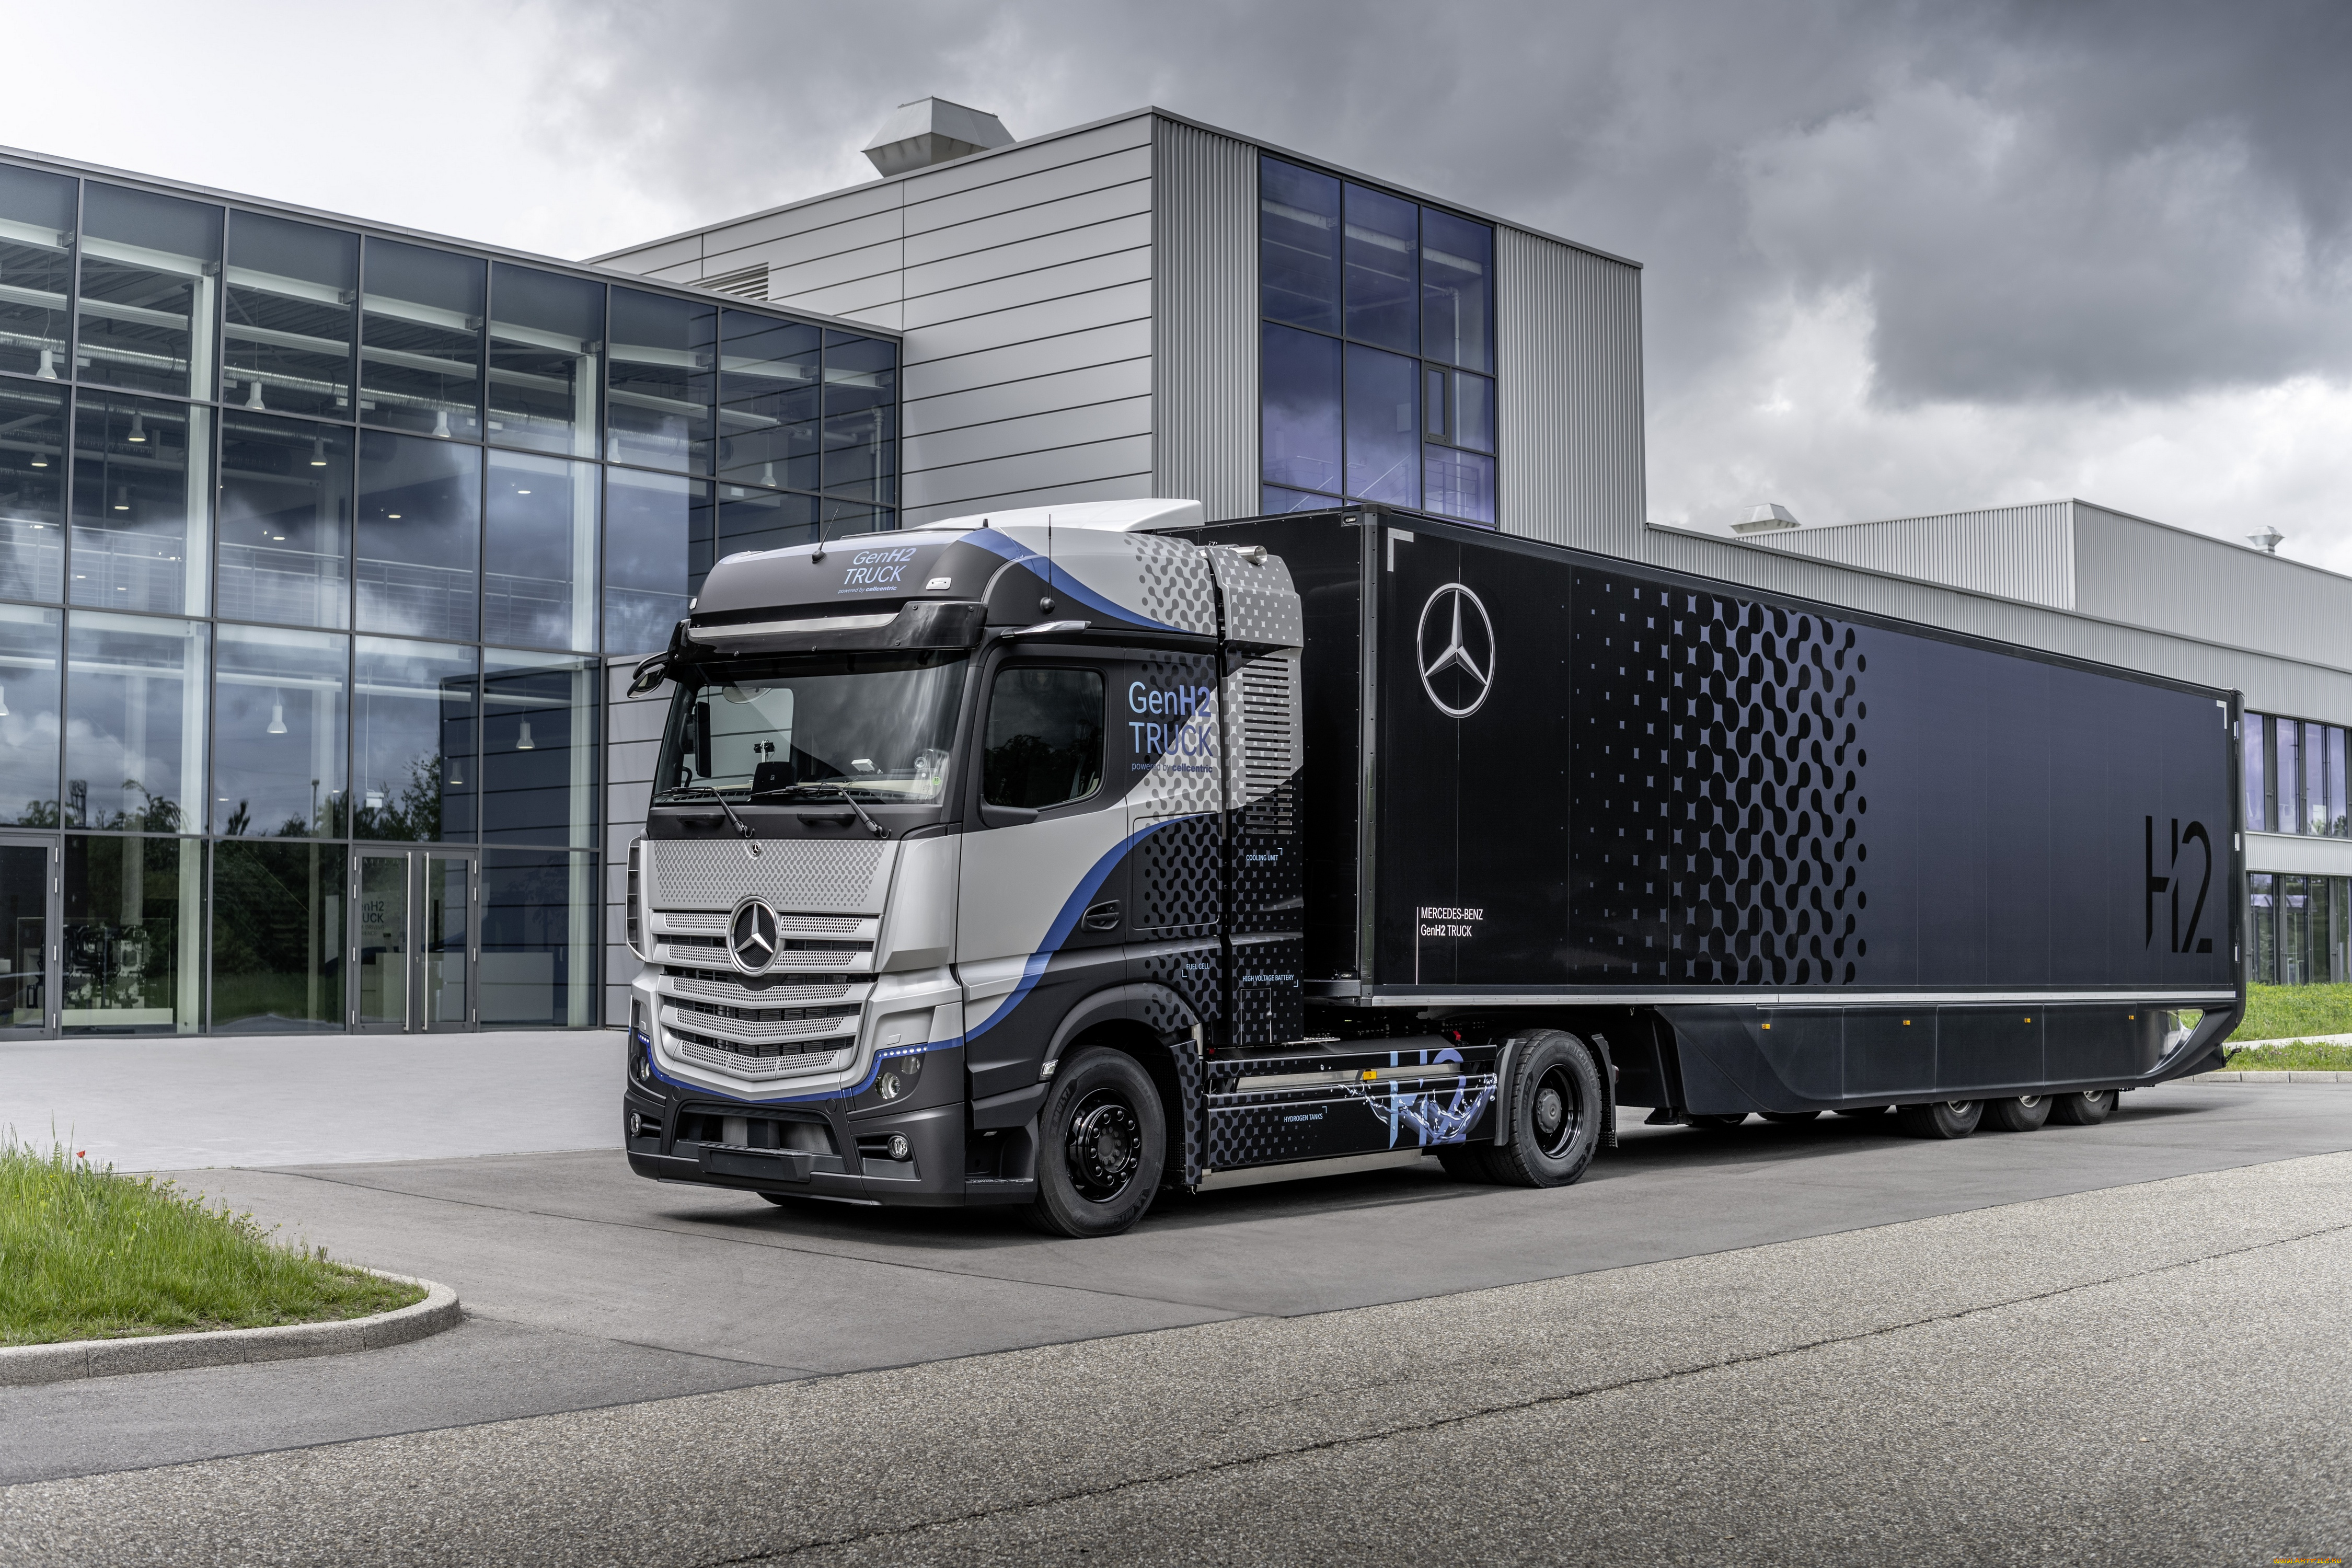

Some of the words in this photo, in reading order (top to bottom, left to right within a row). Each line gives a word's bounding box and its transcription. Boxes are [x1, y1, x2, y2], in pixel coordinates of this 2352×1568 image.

[853, 548, 917, 565] GenH2
[844, 565, 907, 585] TRUCK
[1128, 681, 1212, 718] GenH2
[1128, 721, 1214, 757] TRUCK
[1132, 762, 1161, 771] powered
[1162, 763, 1171, 773] by
[1172, 763, 1213, 773] cellcentric
[2146, 815, 2212, 954] H2
[1421, 907, 1483, 920] MERCEDES-BENZ
[1421, 924, 1446, 936] GenH2
[1447, 925, 1472, 937] TRUCK
[1566, 1042, 1597, 1090] MICHELIN
[1053, 1087, 1071, 1123] MULTI
[1284, 1114, 1308, 1123] HYDROGEN
